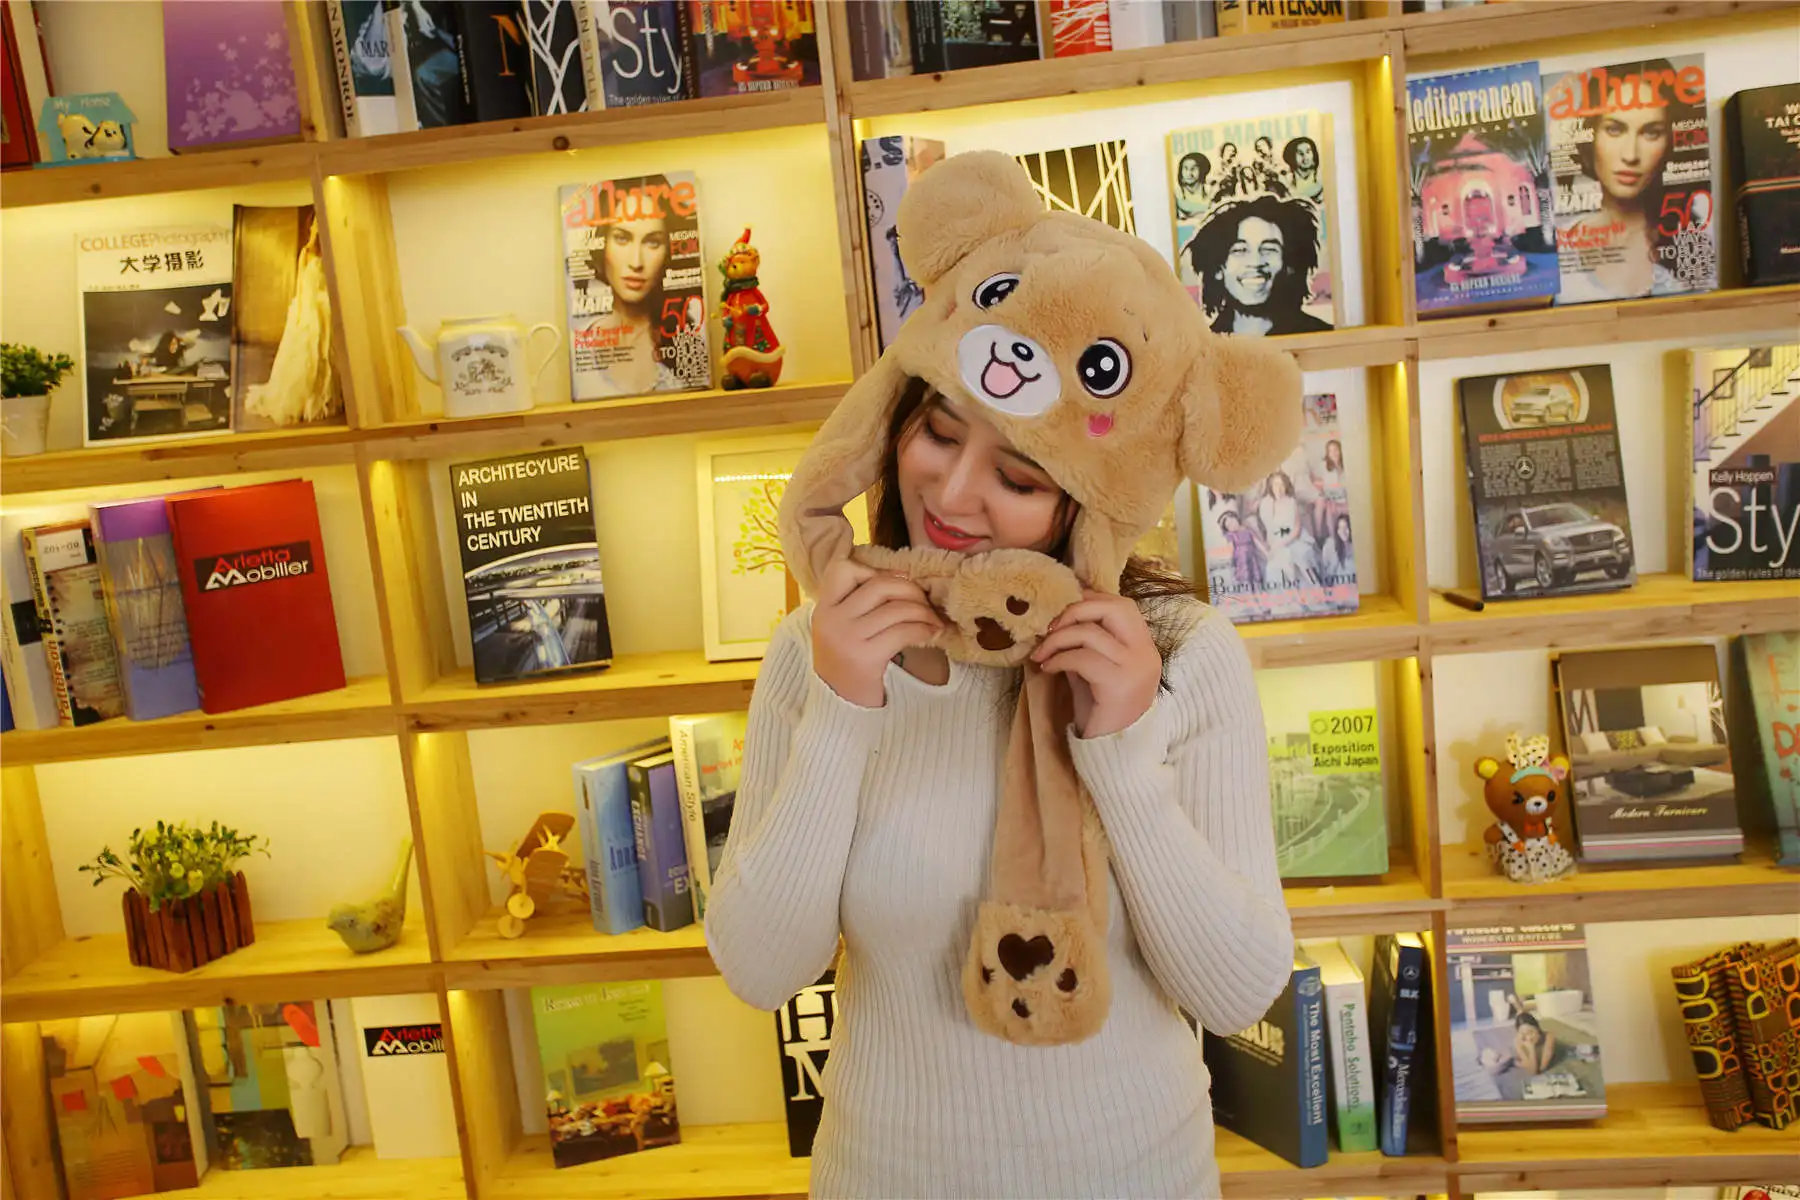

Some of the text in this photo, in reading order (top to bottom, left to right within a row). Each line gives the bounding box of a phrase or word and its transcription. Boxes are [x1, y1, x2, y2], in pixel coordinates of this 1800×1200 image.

[1549, 64, 1705, 120] allure
[1171, 114, 1309, 155] BOB MARLEY
[565, 180, 697, 228] allure
[1657, 188, 1714, 237] 50
[120, 249, 204, 274] 大学摄影
[659, 294, 705, 338] 50
[458, 454, 581, 487] ARCHITECYURE
[1711, 470, 1774, 484] Kelly Hoppen
[461, 490, 478, 509] IN
[464, 497, 590, 531] THE TWENTIETH
[467, 525, 542, 552] CENTURY
[1706, 486, 1800, 568] Sty
[48, 640, 73, 721] Patterson
[1331, 715, 1374, 734] 2007
[1313, 742, 1375, 755] Exposition
[1314, 755, 1379, 769] Aichi Japan
[679, 729, 697, 822] American Style
[1609, 806, 1651, 820] Modern
[1308, 1002, 1324, 1126] The Most Excellent
